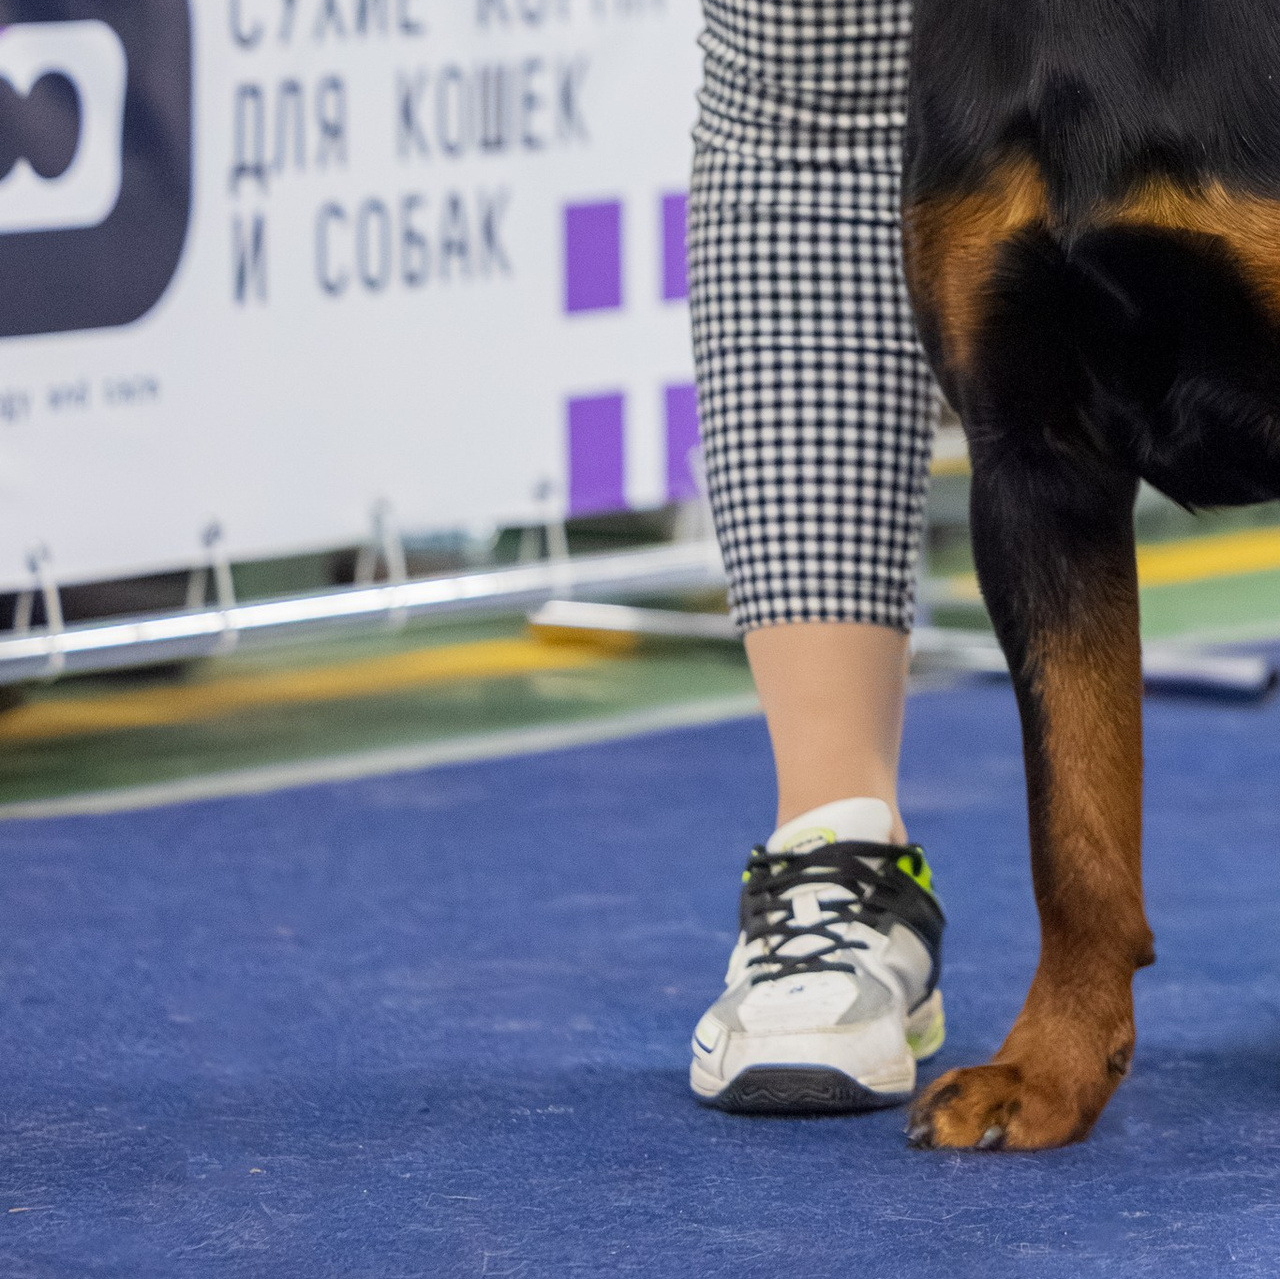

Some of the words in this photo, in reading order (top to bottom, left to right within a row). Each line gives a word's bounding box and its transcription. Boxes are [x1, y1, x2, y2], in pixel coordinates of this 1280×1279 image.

[229, 69, 350, 198] ДЛЯ
[396, 53, 594, 161] КОШЕК
[231, 207, 269, 307] И
[314, 185, 514, 298] СОБАК
